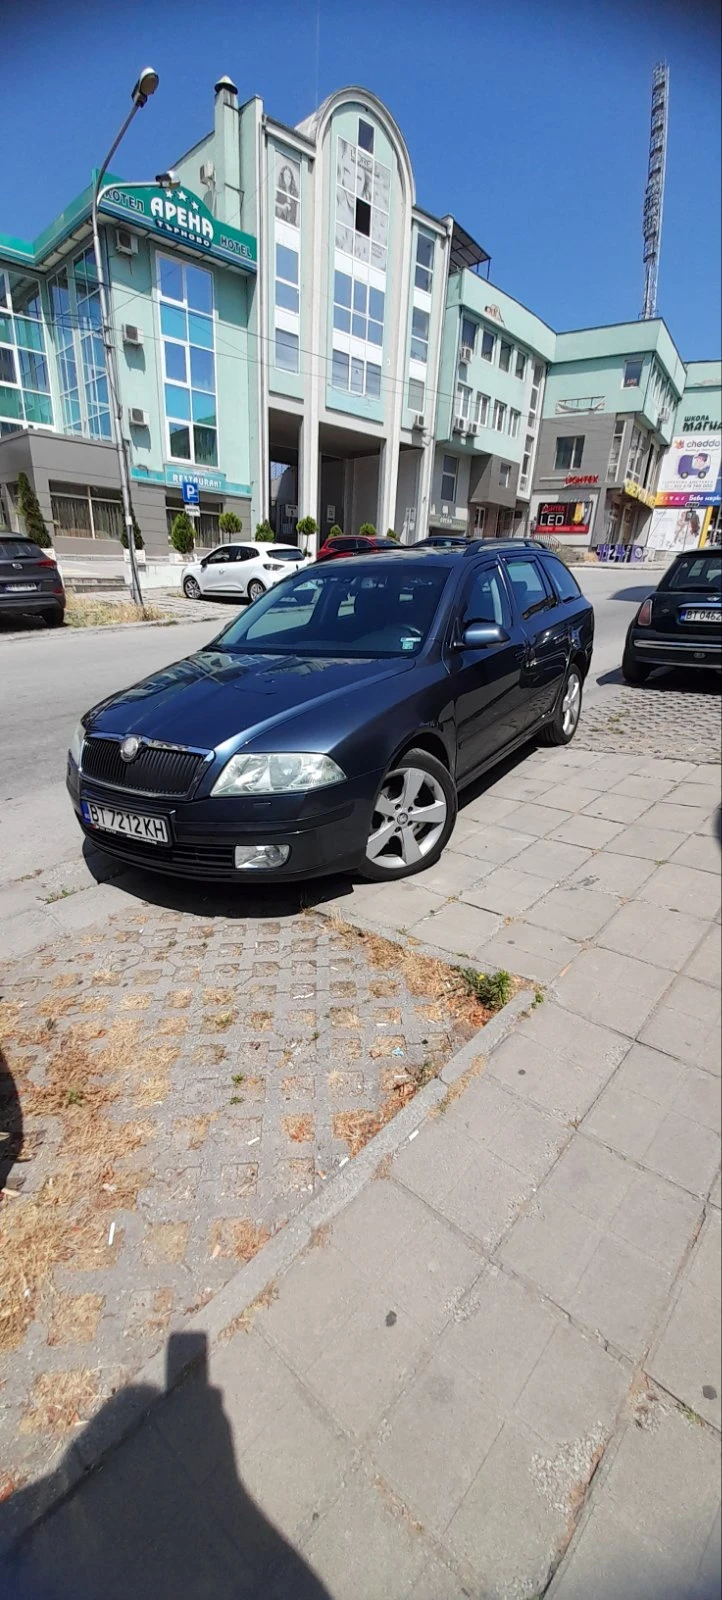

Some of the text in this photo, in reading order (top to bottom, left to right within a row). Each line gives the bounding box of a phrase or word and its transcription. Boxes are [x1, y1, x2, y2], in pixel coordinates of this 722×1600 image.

[150, 197, 214, 240] АРЕНА
[157, 220, 211, 247] ТЪРНОВО
[220, 235, 252, 259] HOTEL
[684, 414, 709, 422] ШКОЛА
[172, 474, 222, 488] RESTAURANT
[186, 484, 195, 500] P
[540, 514, 565, 526] LED
